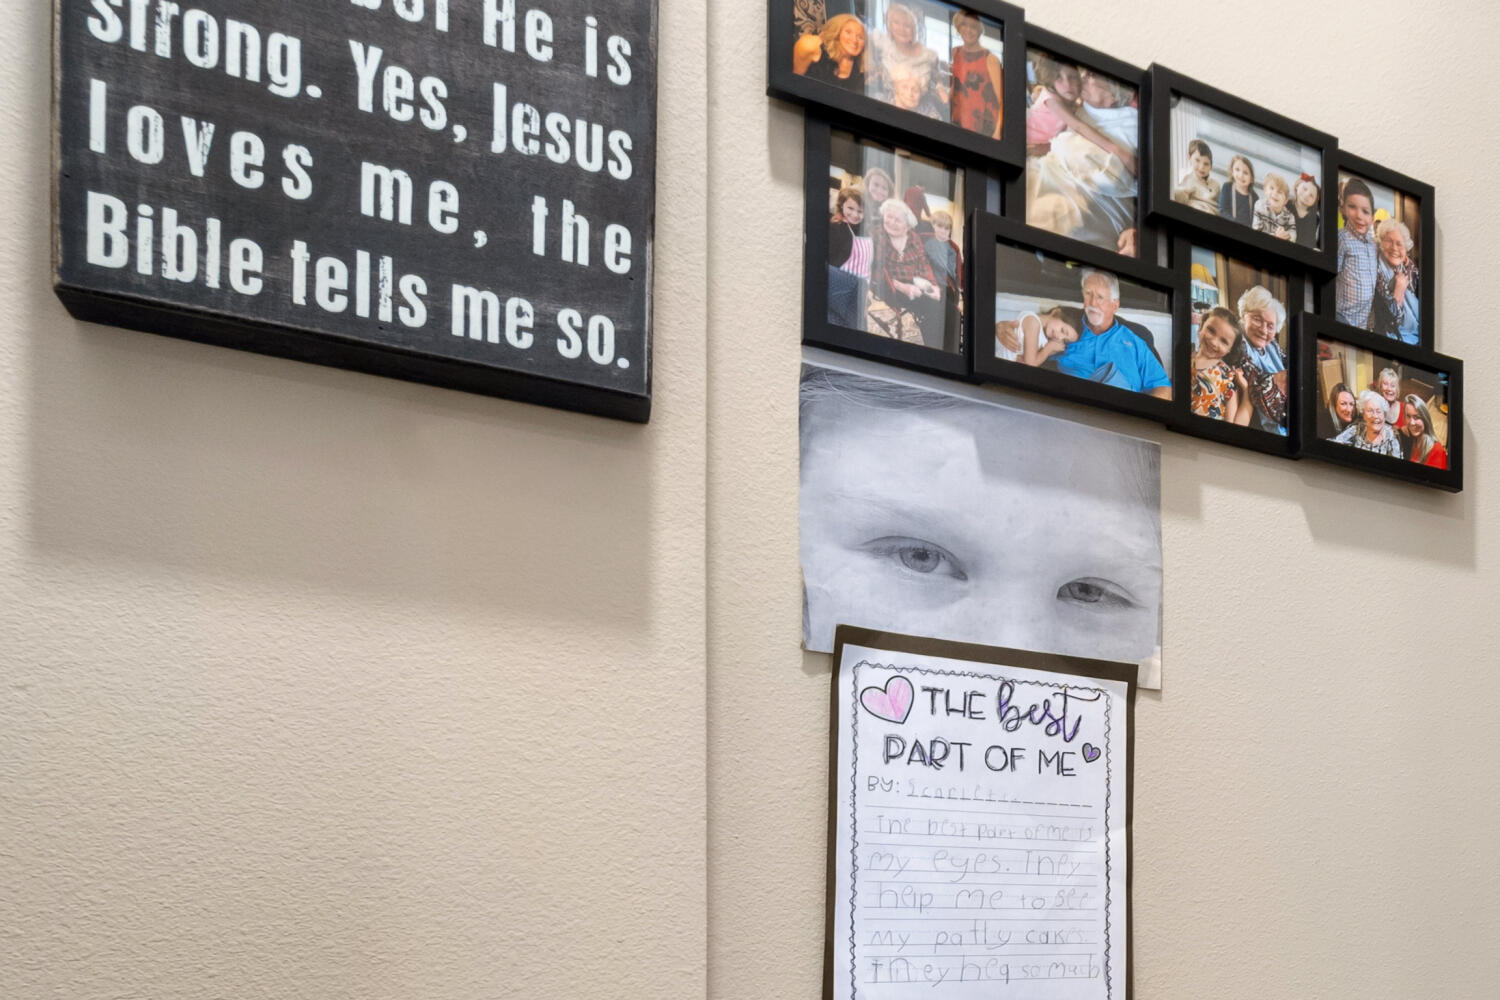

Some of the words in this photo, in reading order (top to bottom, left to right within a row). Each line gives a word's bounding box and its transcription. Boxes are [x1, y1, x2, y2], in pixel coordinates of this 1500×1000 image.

[483, 0, 553, 62] He
[585, 16, 632, 86] is
[87, 0, 323, 98] strong.
[349, 39, 468, 143] Yes,
[491, 82, 633, 181] Jesus
[89, 78, 314, 201] loves
[360, 160, 489, 249] me,
[531, 195, 633, 276] the
[86, 190, 264, 296] Bible
[290, 240, 428, 329] tells
[451, 283, 535, 350] me
[556, 305, 631, 369] so.
[922, 686, 987, 720] THE
[998, 681, 1101, 742] best
[867, 776, 900, 793] BY:
[884, 735, 972, 771] PART
[984, 745, 1026, 772] OF
[1038, 750, 1076, 776] ME
[933, 849, 1010, 882] eyes.
[954, 888, 1003, 909] me
[1021, 894, 1045, 909] to
